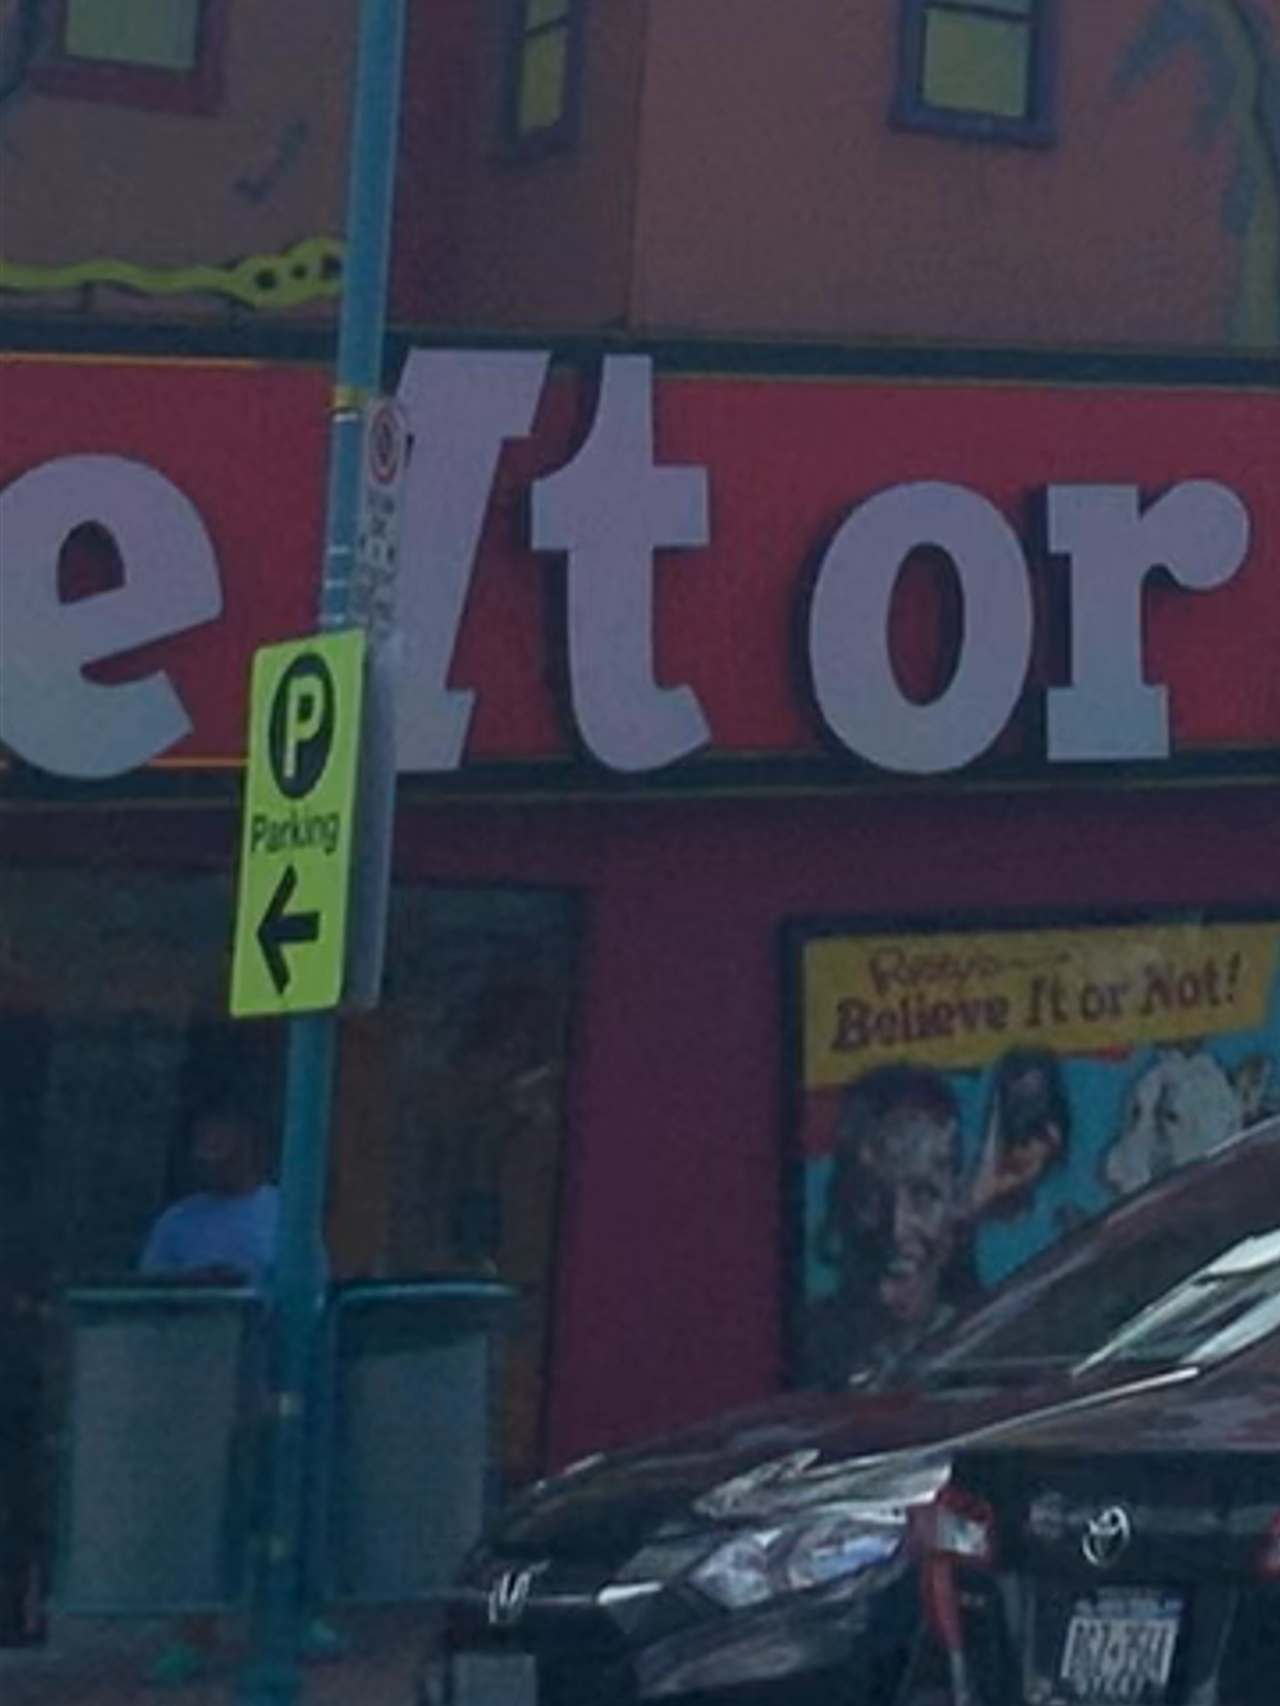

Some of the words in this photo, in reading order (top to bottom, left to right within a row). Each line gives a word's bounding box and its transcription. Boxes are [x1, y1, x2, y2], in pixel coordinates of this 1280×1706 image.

[394, 348, 712, 773] It
[809, 479, 1251, 774] or
[283, 675, 325, 778] P
[251, 808, 340, 857] Parking
[831, 993, 1009, 1052] Believe
[1022, 974, 1069, 1027] It
[1080, 979, 1126, 1022] or
[1140, 951, 1241, 1016] Not!
